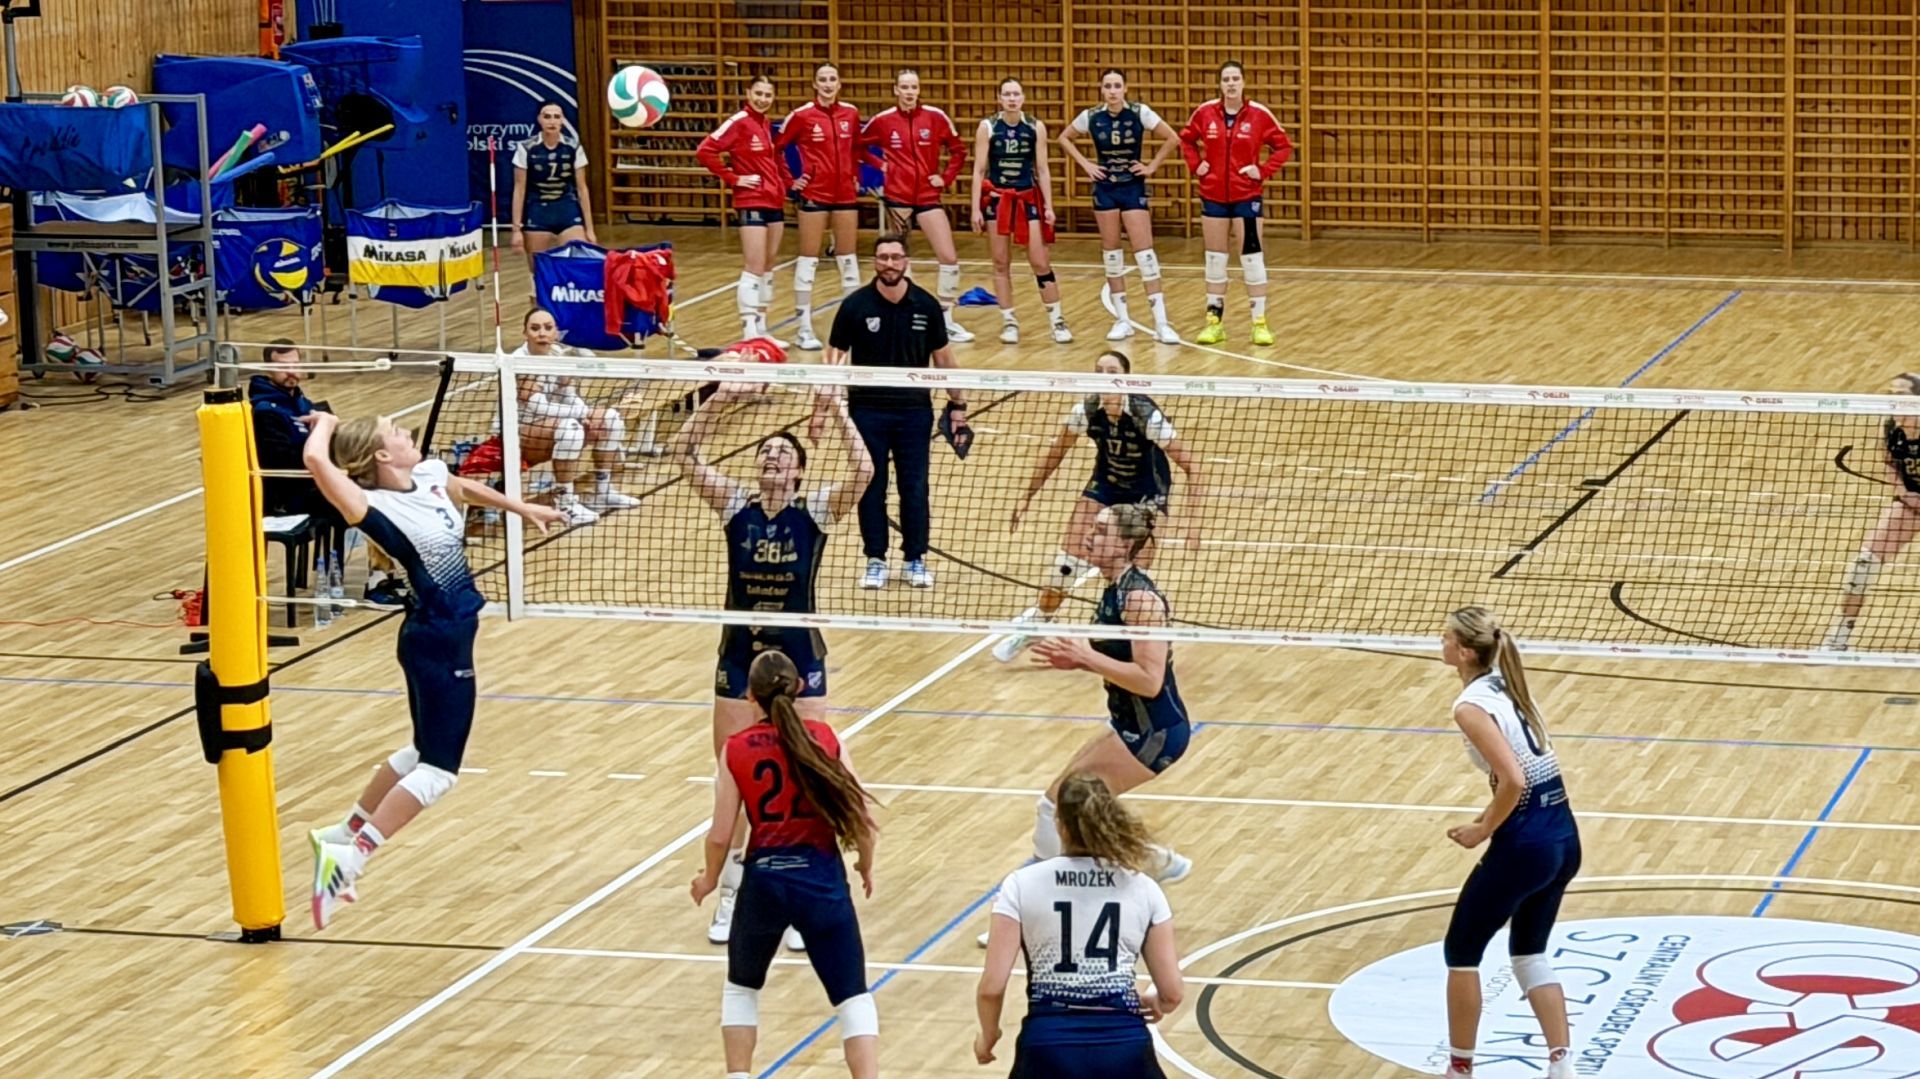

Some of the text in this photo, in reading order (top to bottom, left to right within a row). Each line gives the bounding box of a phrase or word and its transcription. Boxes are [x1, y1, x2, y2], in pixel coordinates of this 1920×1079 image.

[1004, 138, 1019, 154] 12
[435, 507, 456, 530] 3
[753, 538, 782, 564] 36
[1054, 869, 1117, 888] MROŻEK
[1053, 901, 1121, 974] 14
[1633, 934, 1692, 988] CENTRALNY
[1597, 987, 1659, 1035] OŚRODEK
